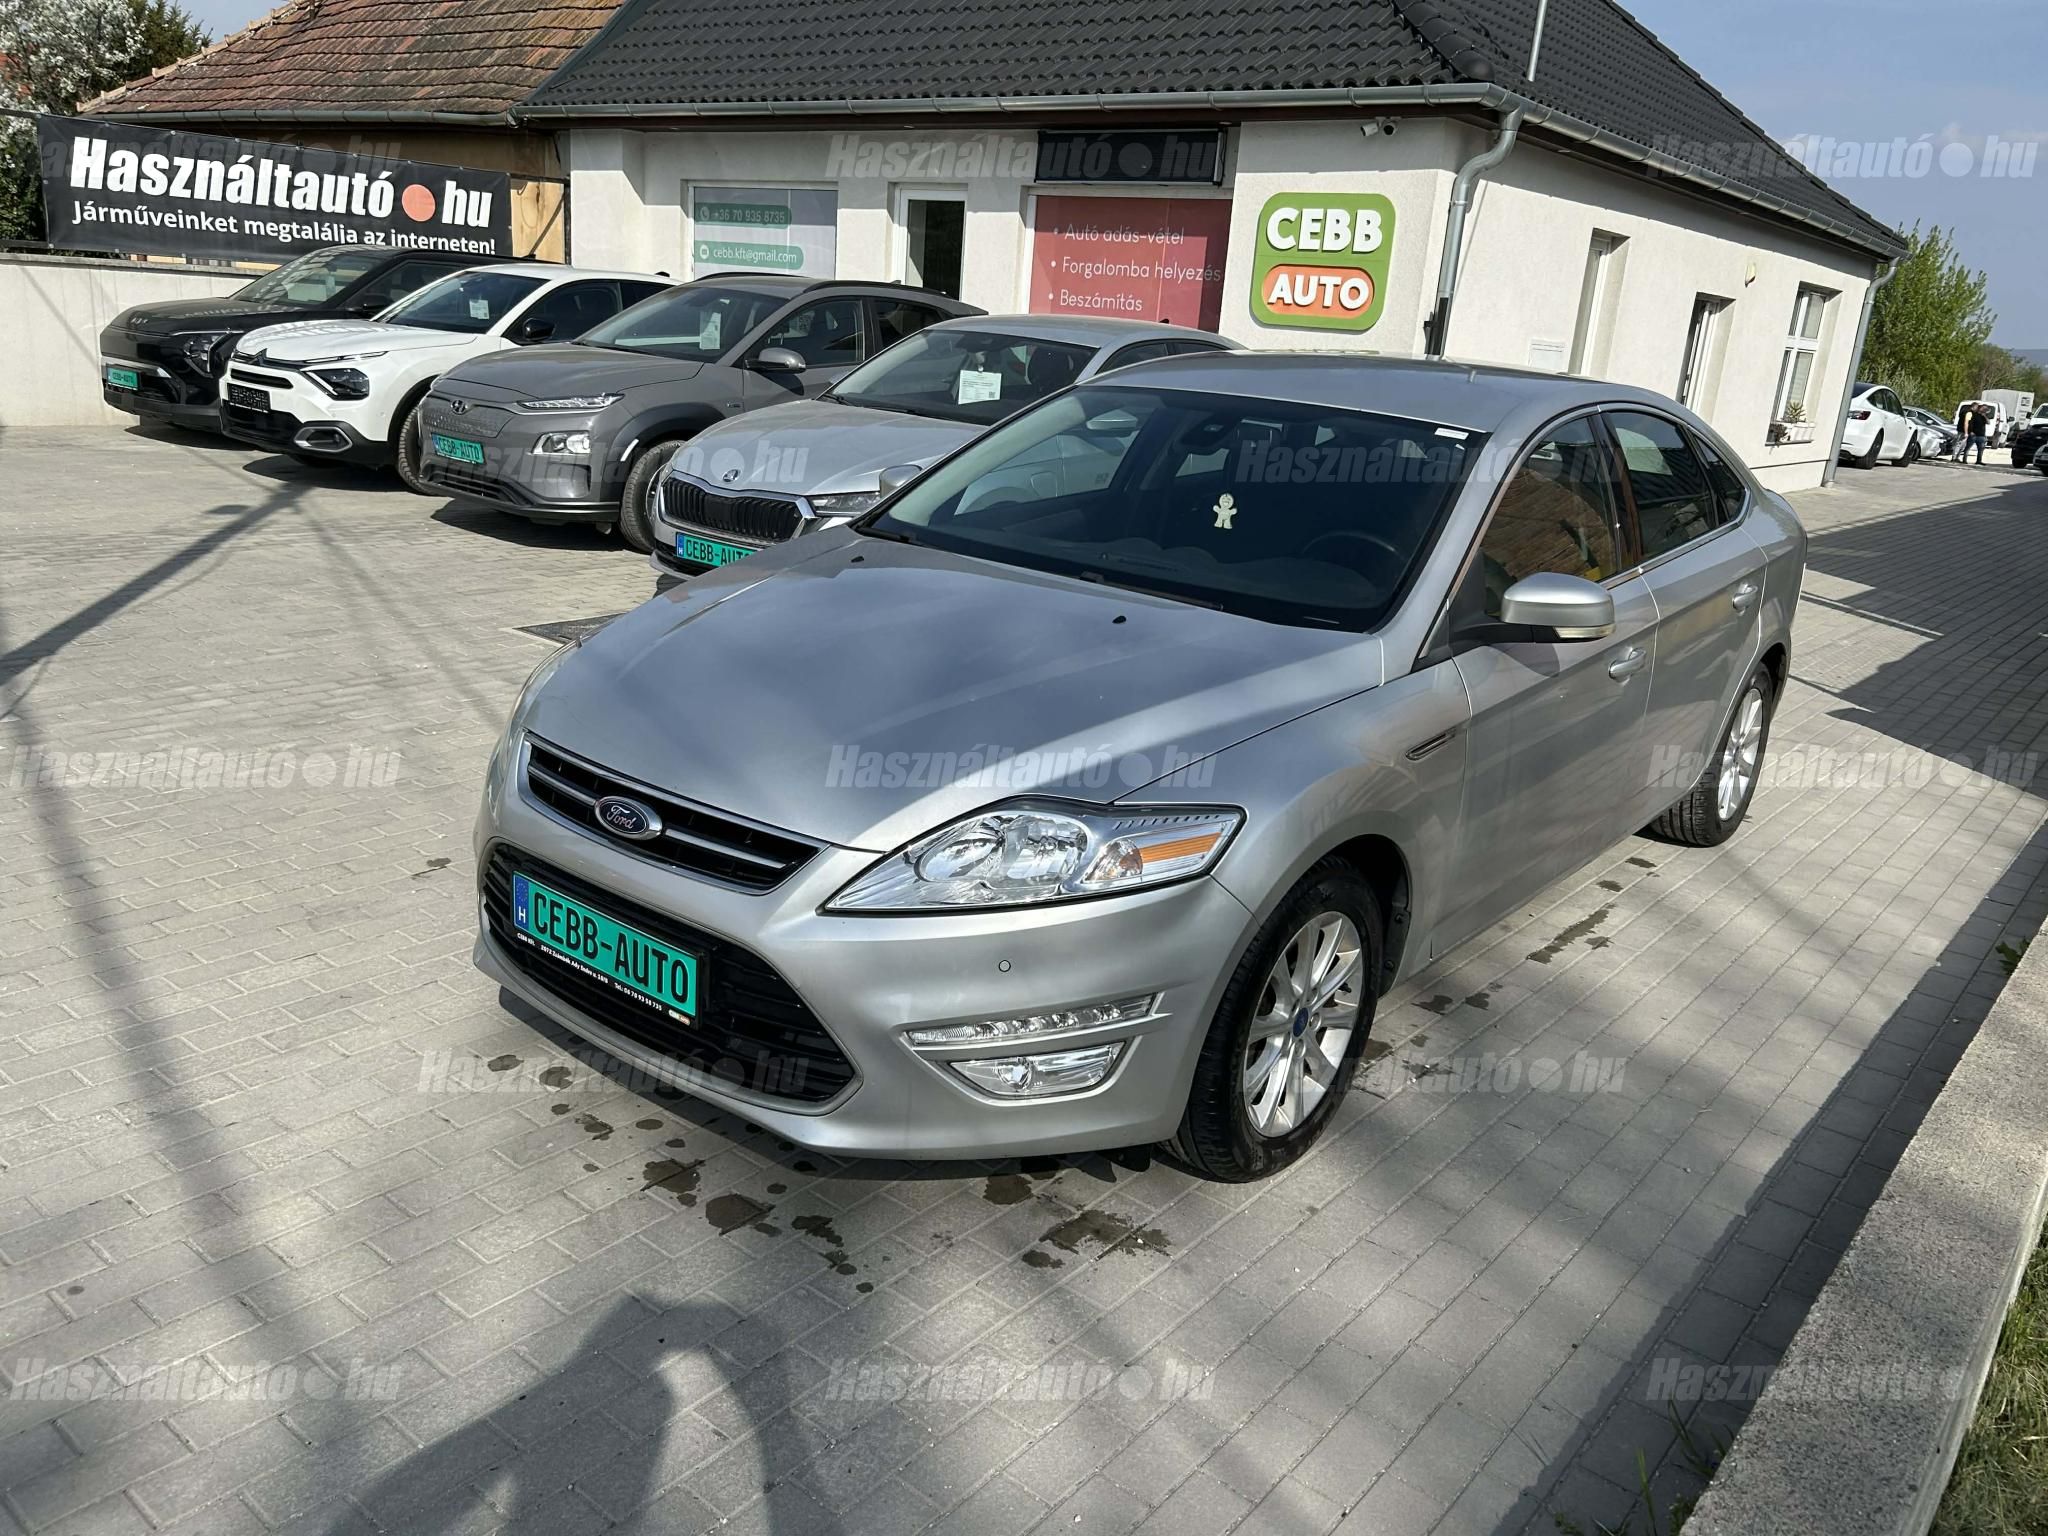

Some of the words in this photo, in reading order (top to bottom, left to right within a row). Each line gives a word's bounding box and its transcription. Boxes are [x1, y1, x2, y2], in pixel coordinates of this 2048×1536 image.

[70, 135, 394, 218] Használtautó
[72, 199, 239, 234] Járműveinket
[244, 219, 358, 244] megtalálja
[363, 230, 386, 246] az
[390, 229, 496, 256] interneten!
[732, 210, 743, 221] 70
[745, 210, 761, 222] 935
[763, 210, 785, 223] 8735
[1064, 223, 1099, 242] Autó
[1102, 225, 1185, 246] adás-vétel
[1265, 206, 1383, 254] CEBB
[713, 247, 798, 263] cebb.kft@gmail.com
[1062, 256, 1150, 279] Forgalomba
[1154, 260, 1222, 284] helyezés
[1060, 288, 1143, 312] Beszámítás
[1267, 272, 1370, 310] AUTO
[437, 436, 480, 461] CEBB-AUTO
[686, 539, 750, 565] CEBB-AUT
[606, 805, 637, 829] Ford
[534, 891, 690, 1004] CEBB-AUTO
